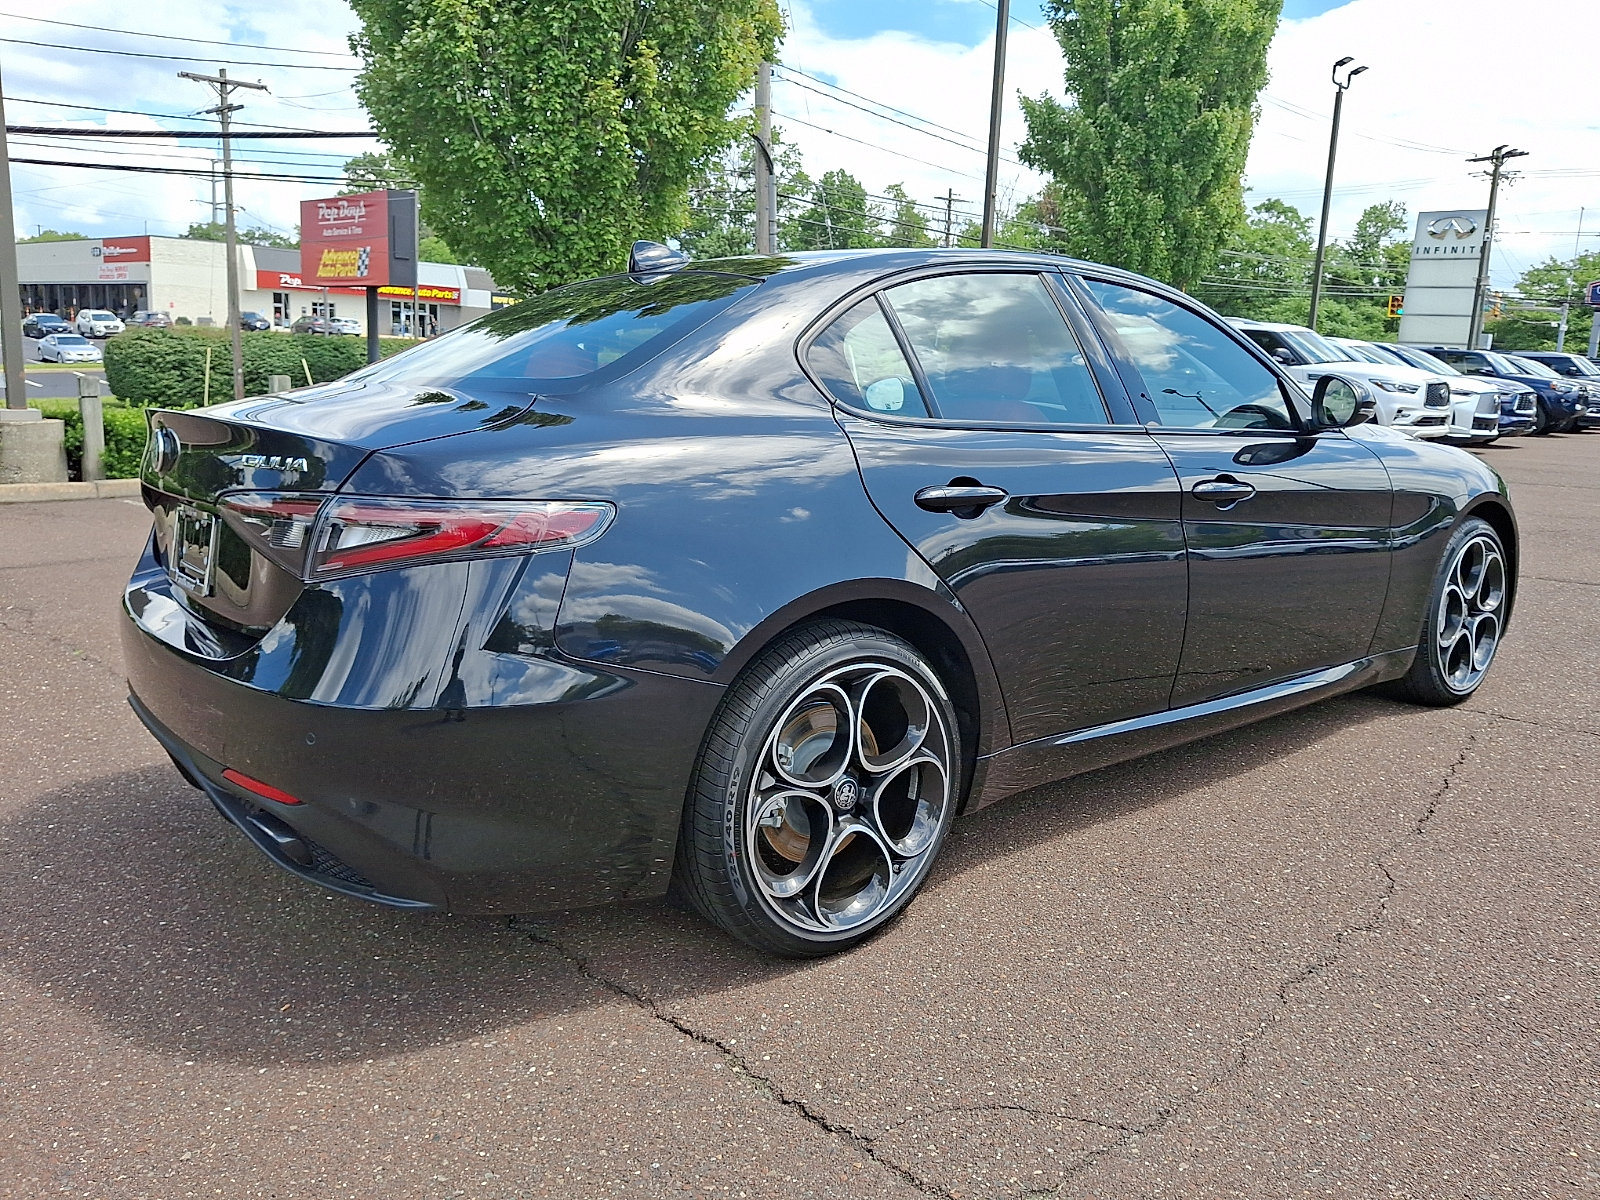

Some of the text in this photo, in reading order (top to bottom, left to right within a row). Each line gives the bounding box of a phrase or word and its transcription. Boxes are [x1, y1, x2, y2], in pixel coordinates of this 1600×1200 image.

[317, 200, 366, 223] Pep Boys
[316, 264, 357, 277] Auto Parts
[377, 286, 411, 296] Advance
[431, 289, 453, 299] Parts
[241, 454, 308, 472] GIULIA
[728, 767, 740, 806] R19
[725, 810, 741, 889] 225/40
